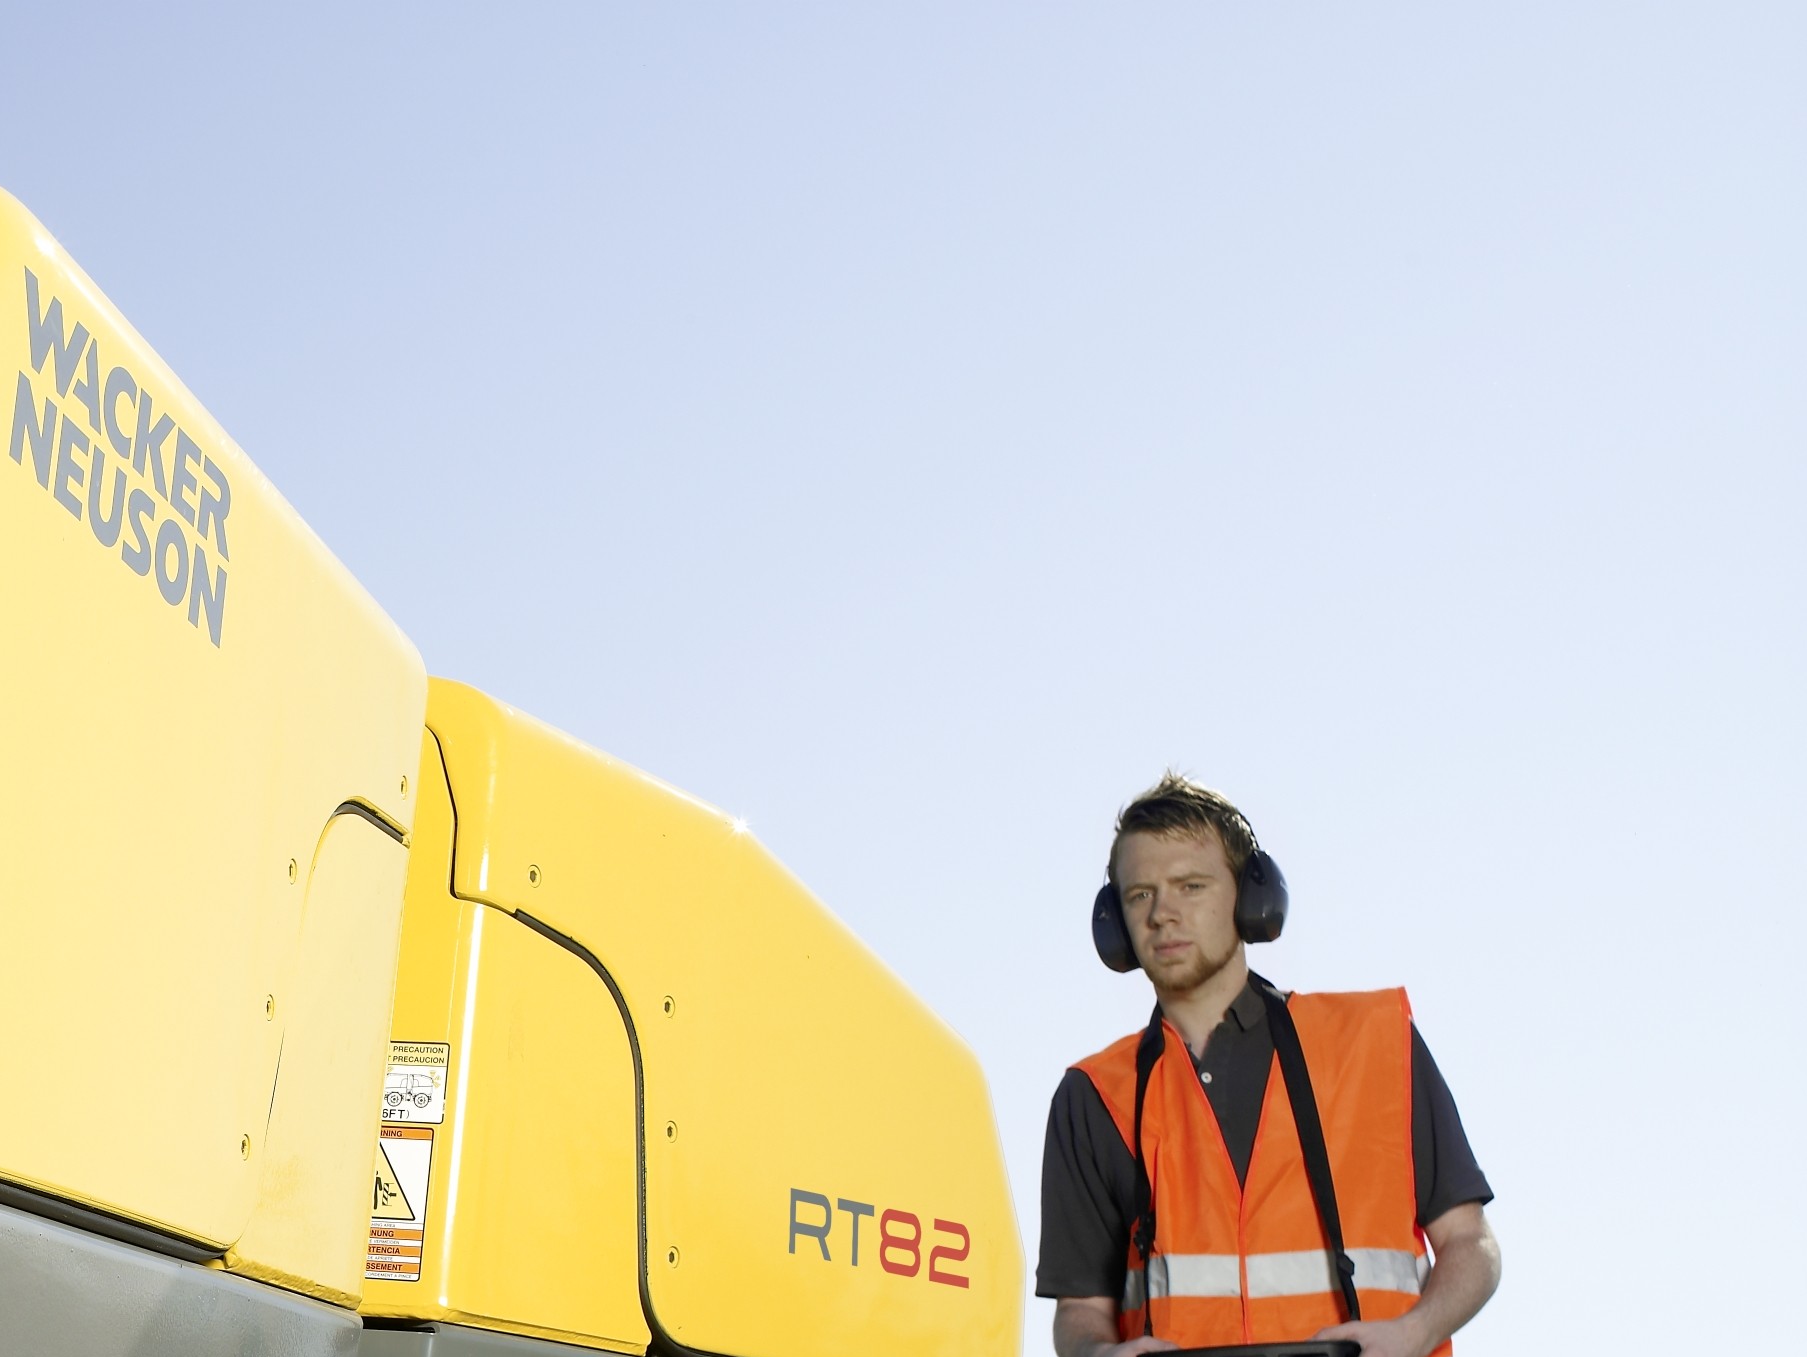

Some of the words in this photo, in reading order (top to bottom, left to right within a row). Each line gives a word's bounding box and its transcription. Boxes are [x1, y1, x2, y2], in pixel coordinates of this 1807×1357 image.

[24, 265, 231, 562] WACKER
[9, 370, 228, 649] NEUSON
[392, 1055, 445, 1064] PRECAUCION
[393, 1045, 444, 1054] PRECAUTION
[788, 1187, 971, 1289] RT82
